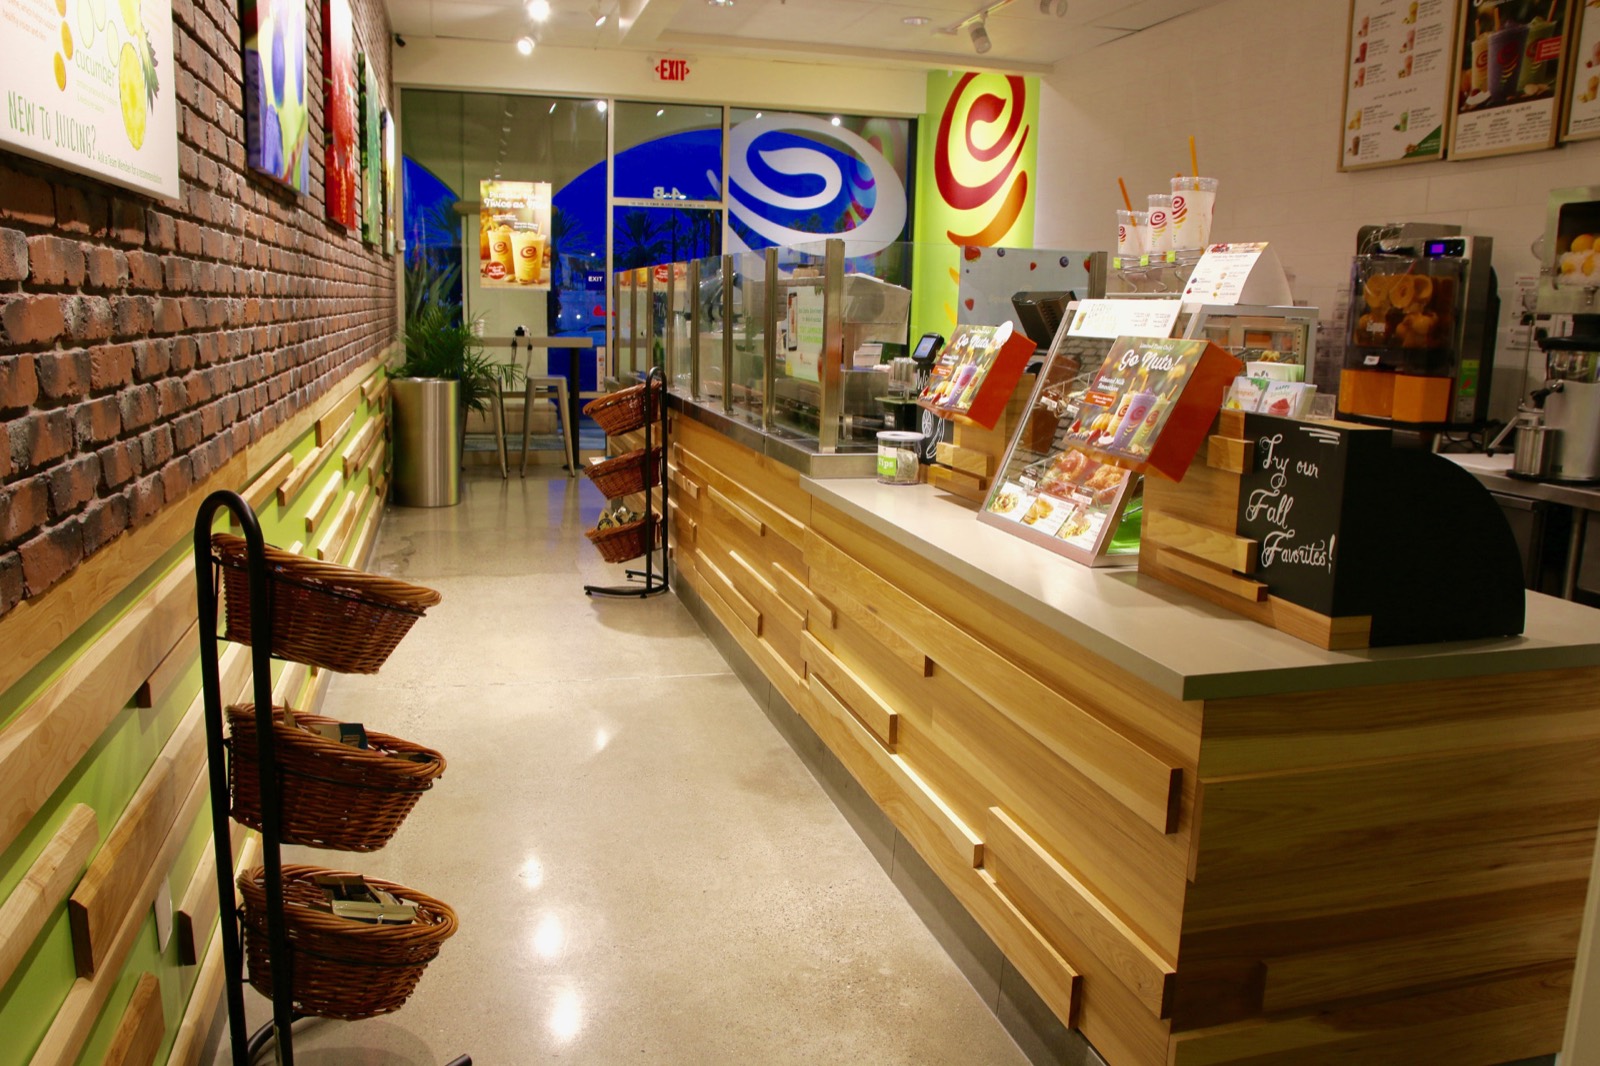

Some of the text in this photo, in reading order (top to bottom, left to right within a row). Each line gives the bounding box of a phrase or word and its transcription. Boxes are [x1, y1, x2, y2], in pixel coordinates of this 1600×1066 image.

[660, 59, 687, 81] EXIT
[7, 89, 35, 137] NEW
[54, 110, 97, 160] JUICING?
[955, 333, 969, 350] Go
[1118, 349, 1184, 371] Go Nuts!
[1259, 434, 1319, 490] Try our
[1245, 489, 1294, 529] Fall
[1261, 529, 1336, 574] Favorites!
